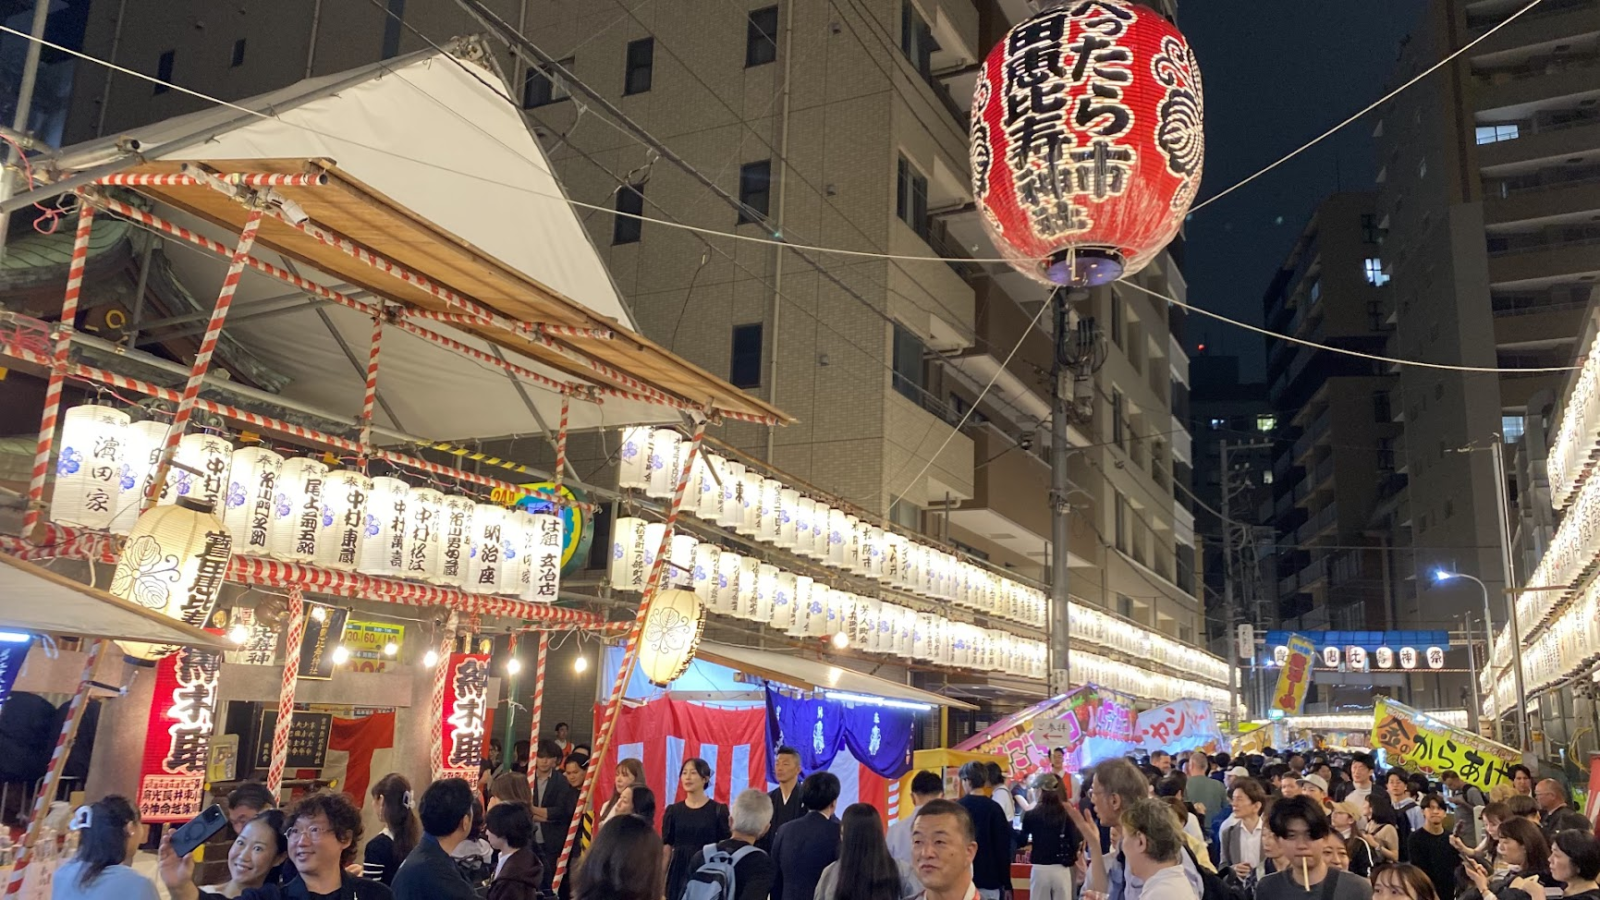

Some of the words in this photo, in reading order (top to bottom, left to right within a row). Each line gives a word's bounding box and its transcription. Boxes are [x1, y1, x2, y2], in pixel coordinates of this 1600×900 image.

[85, 435, 120, 513] 濱田家
[478, 524, 502, 585] 明治座
